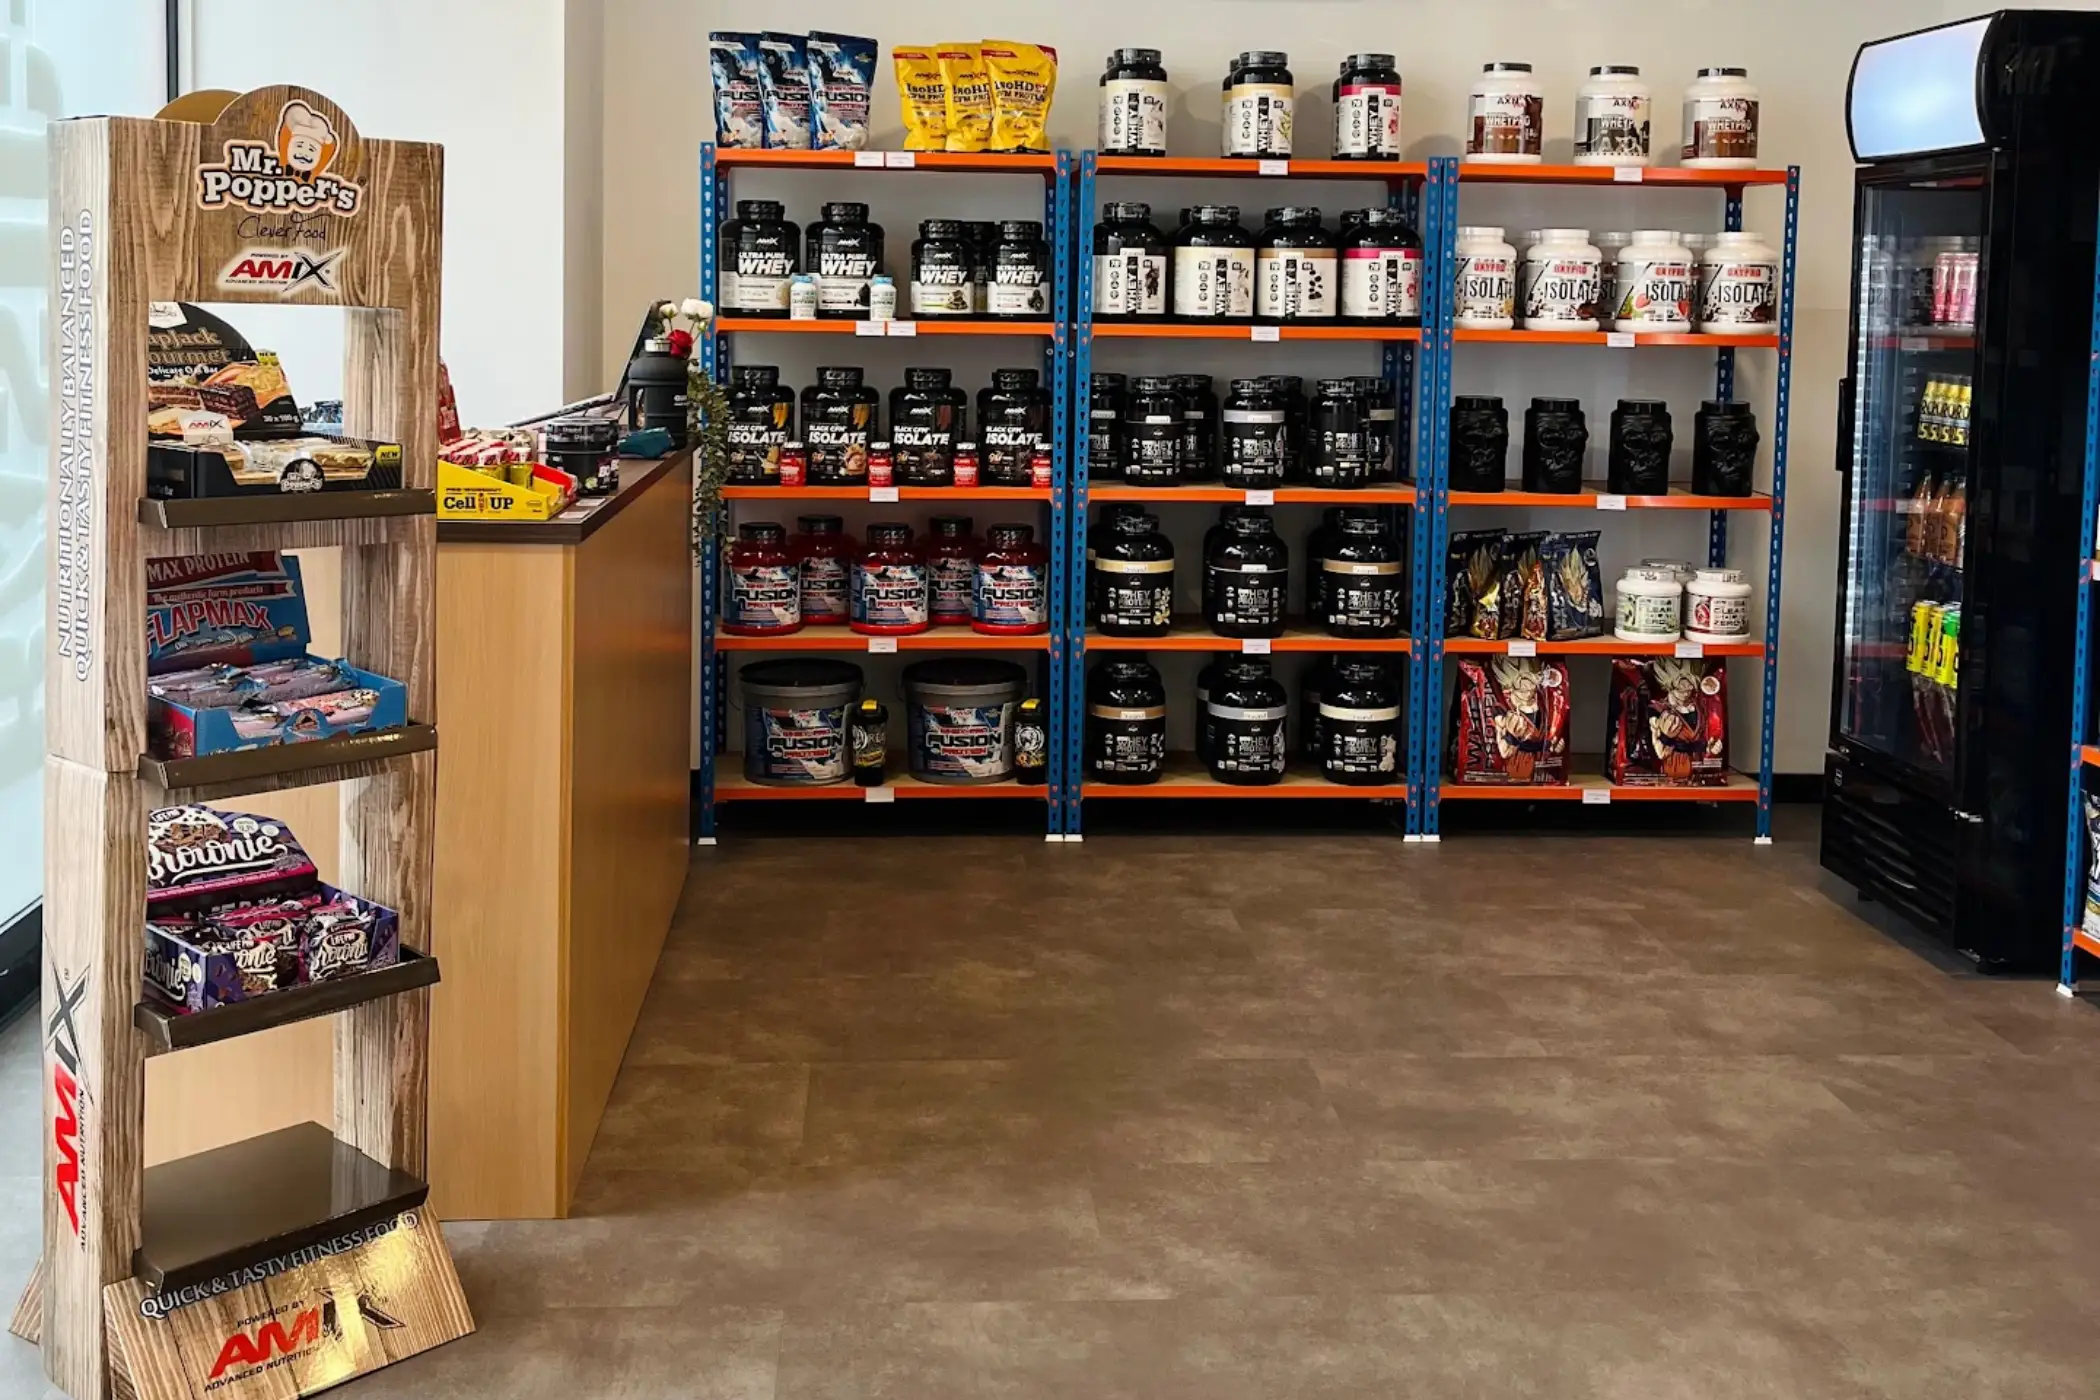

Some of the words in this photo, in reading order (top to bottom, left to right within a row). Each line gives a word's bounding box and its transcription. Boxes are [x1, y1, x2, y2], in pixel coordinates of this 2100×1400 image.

[231, 147, 283, 175] Mr.
[203, 171, 357, 211] Popper's
[237, 216, 292, 239] Clever
[290, 212, 332, 242] Food
[78, 208, 94, 306] FOOD
[738, 259, 795, 275] WHEY
[821, 261, 876, 276] WHEY
[229, 251, 343, 293] AMIX
[920, 271, 967, 284] WHEY
[996, 271, 1043, 284] WHEY
[60, 225, 76, 398] BALANCED
[149, 349, 232, 365] ourmet
[77, 311, 93, 437] FITNESS
[728, 431, 787, 444] ISOLATE
[808, 432, 867, 444] ISOLATE
[893, 433, 950, 445] ISOLATE
[985, 433, 1043, 445] ISOLATE
[76, 443, 93, 539] TASTY
[444, 496, 476, 509] Cell
[490, 497, 514, 509] UP
[58, 399, 76, 658] NUTRITIONALLY
[76, 541, 92, 573] &
[148, 560, 184, 582] MAX
[184, 552, 250, 575] PROTEIN
[734, 588, 797, 600] FUSION
[864, 588, 926, 600] FUSION
[982, 588, 1044, 600] FUSION
[75, 574, 93, 682] QUICK
[768, 733, 843, 750] FUSION
[928, 733, 1001, 747] FUSION
[46, 960, 94, 1236] AMIX
[140, 1280, 210, 1318] QUICK
[211, 1276, 229, 1294] &
[228, 1255, 290, 1289] TASTY
[289, 1231, 365, 1268] FITNESS
[364, 1212, 419, 1243] FOOD
[237, 1304, 288, 1328] POWERED
[292, 1300, 305, 1310] BY
[204, 1366, 263, 1392] ADVANCED
